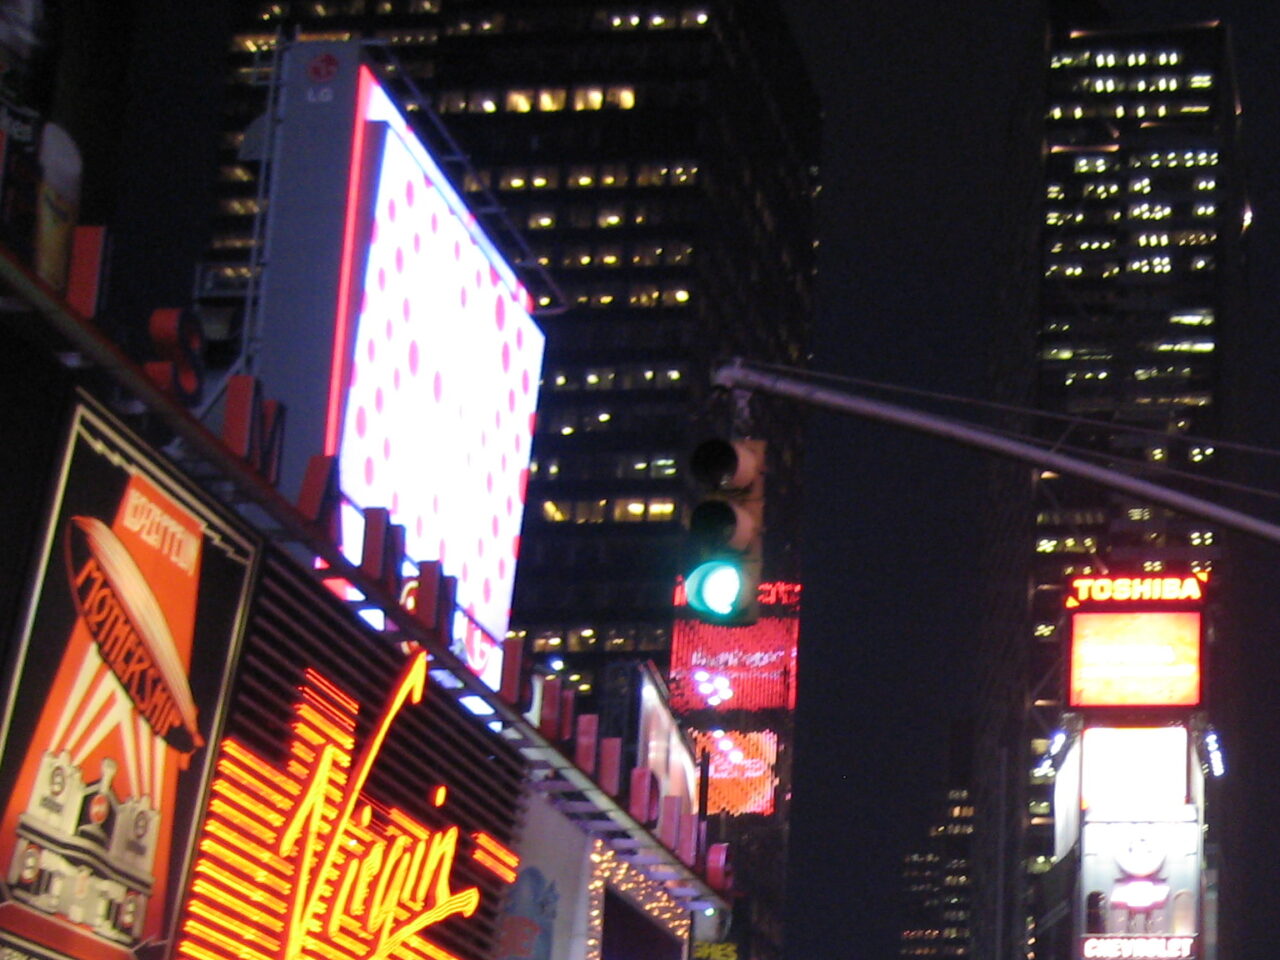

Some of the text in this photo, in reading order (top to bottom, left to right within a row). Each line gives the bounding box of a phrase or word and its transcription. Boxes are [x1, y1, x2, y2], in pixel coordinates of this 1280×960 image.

[1073, 578, 1203, 601] TOSHIBA
[73, 556, 183, 738] MOTHERSHIP
[1083, 936, 1195, 960] CHEVROLET
